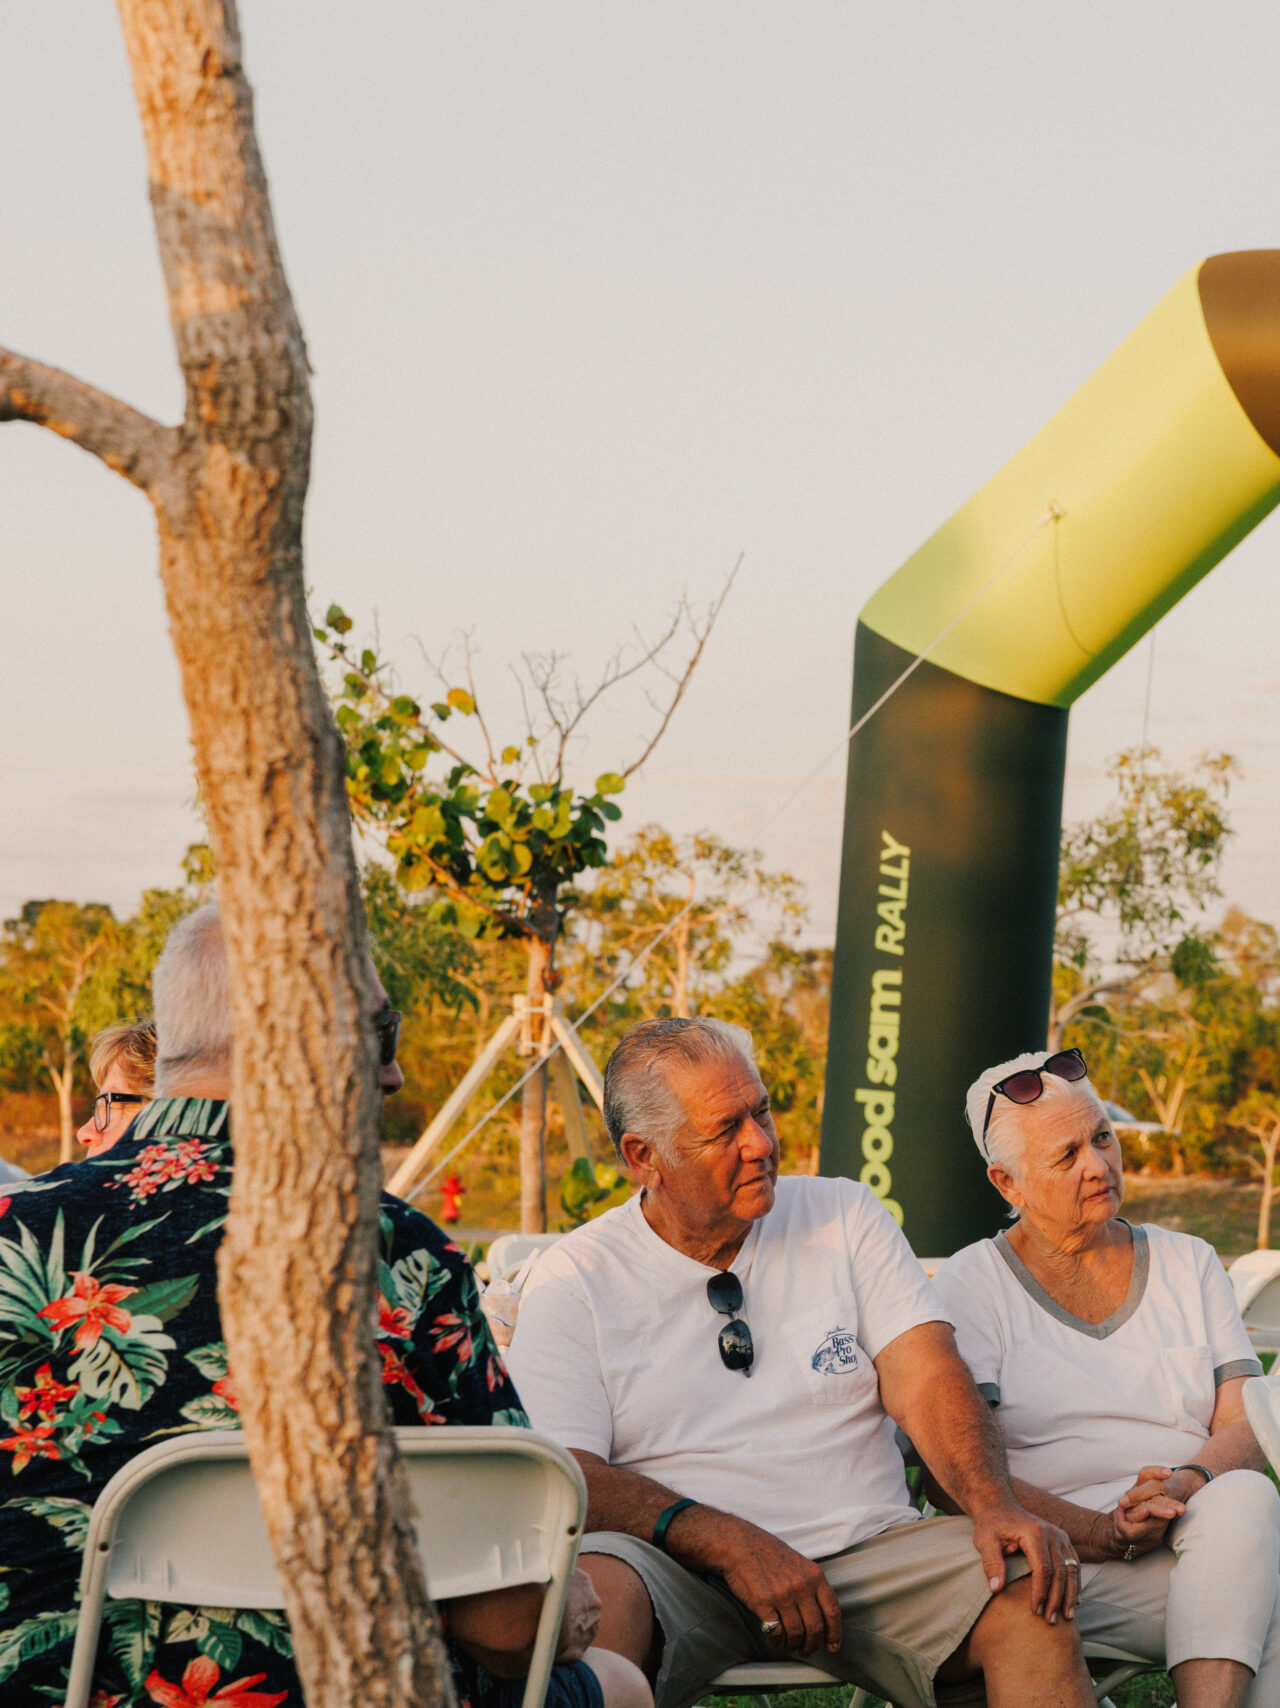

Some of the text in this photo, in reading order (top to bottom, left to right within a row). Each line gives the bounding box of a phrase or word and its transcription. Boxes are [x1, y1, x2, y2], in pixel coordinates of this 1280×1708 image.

[874, 829, 911, 956] RALLY
[866, 967, 903, 1087] sam
[832, 1336, 854, 1348] Bass
[836, 1345, 852, 1357] Pro
[839, 1354, 858, 1366] Sho
